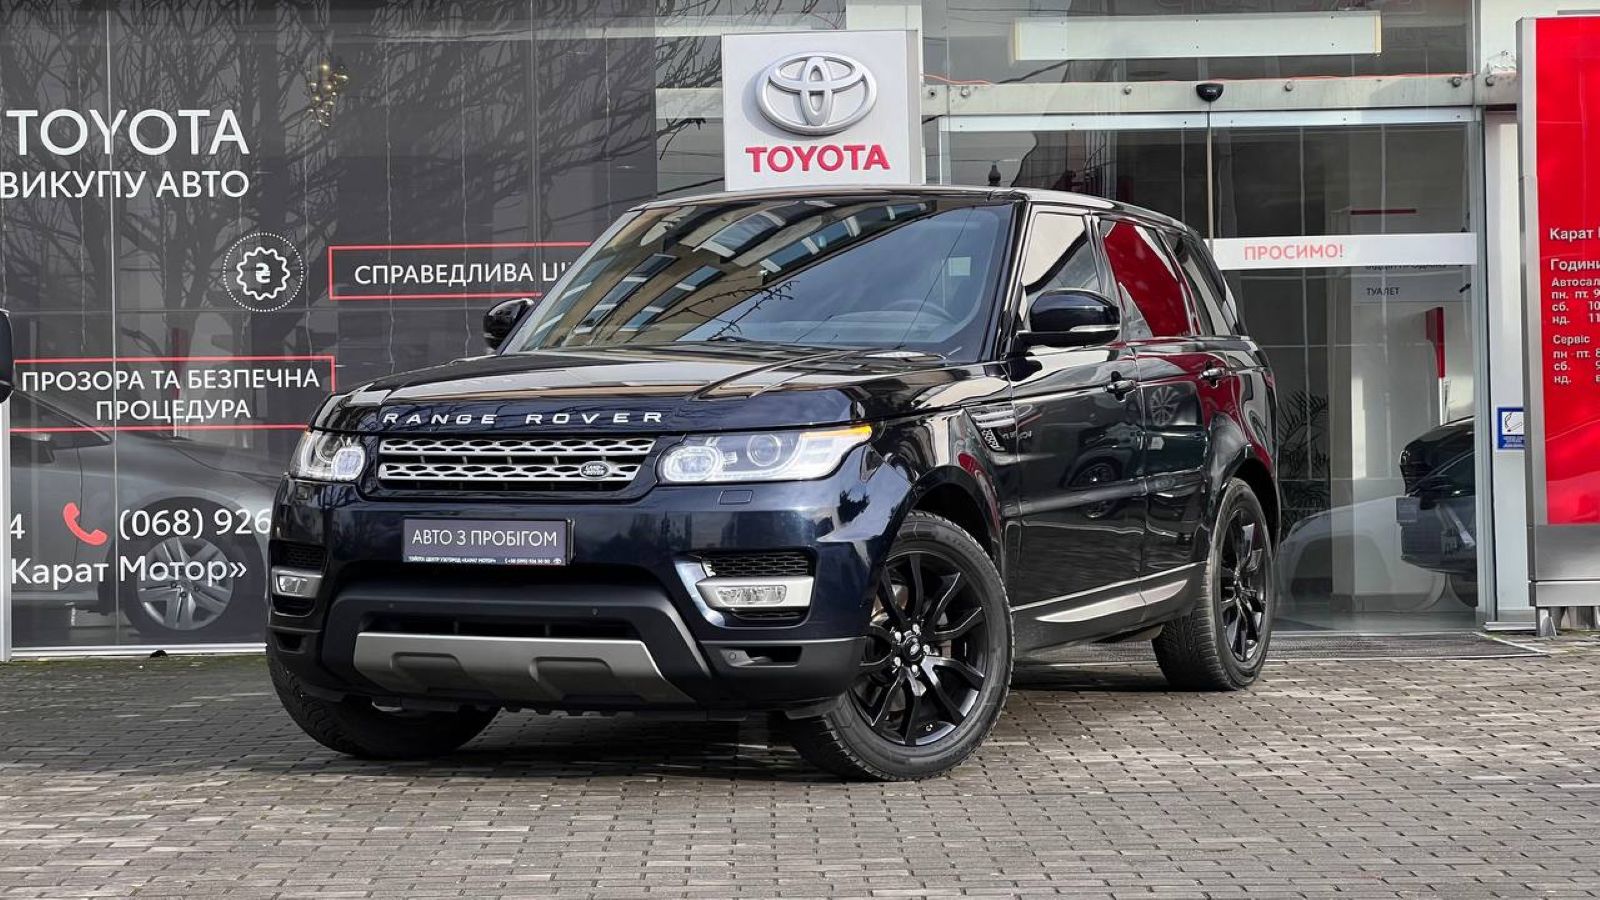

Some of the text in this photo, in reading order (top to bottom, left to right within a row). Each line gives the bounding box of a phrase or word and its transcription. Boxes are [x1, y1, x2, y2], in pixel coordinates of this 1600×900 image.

[6, 109, 250, 155] TOYOTA
[745, 145, 891, 173] TOYOTA
[0, 170, 249, 198] ВИКУПУ АВТО
[1549, 227, 1594, 243] Карат
[1244, 243, 1343, 260] ПРОСИМО!
[355, 263, 533, 287] СПРАВЕДЛИВА
[1366, 286, 1400, 296] ТУАЛЕТ
[1551, 301, 1569, 311] сб.
[1552, 315, 1570, 325] нд.
[1553, 334, 1590, 346] Сервіс
[1554, 361, 1571, 370] сб.
[21, 368, 320, 392] ПРОЗОРА ТА БЕЗПЕЧНА
[1554, 375, 1571, 385] нд.
[96, 399, 251, 422] ПРОЦЕДУРА
[382, 412, 662, 424] RANGE ROVER
[119, 508, 271, 541] (068) 926
[412, 529, 452, 545] АВТО
[471, 530, 557, 547] ПРОБІГОМ
[11, 555, 248, 590] Карат Мотор»
